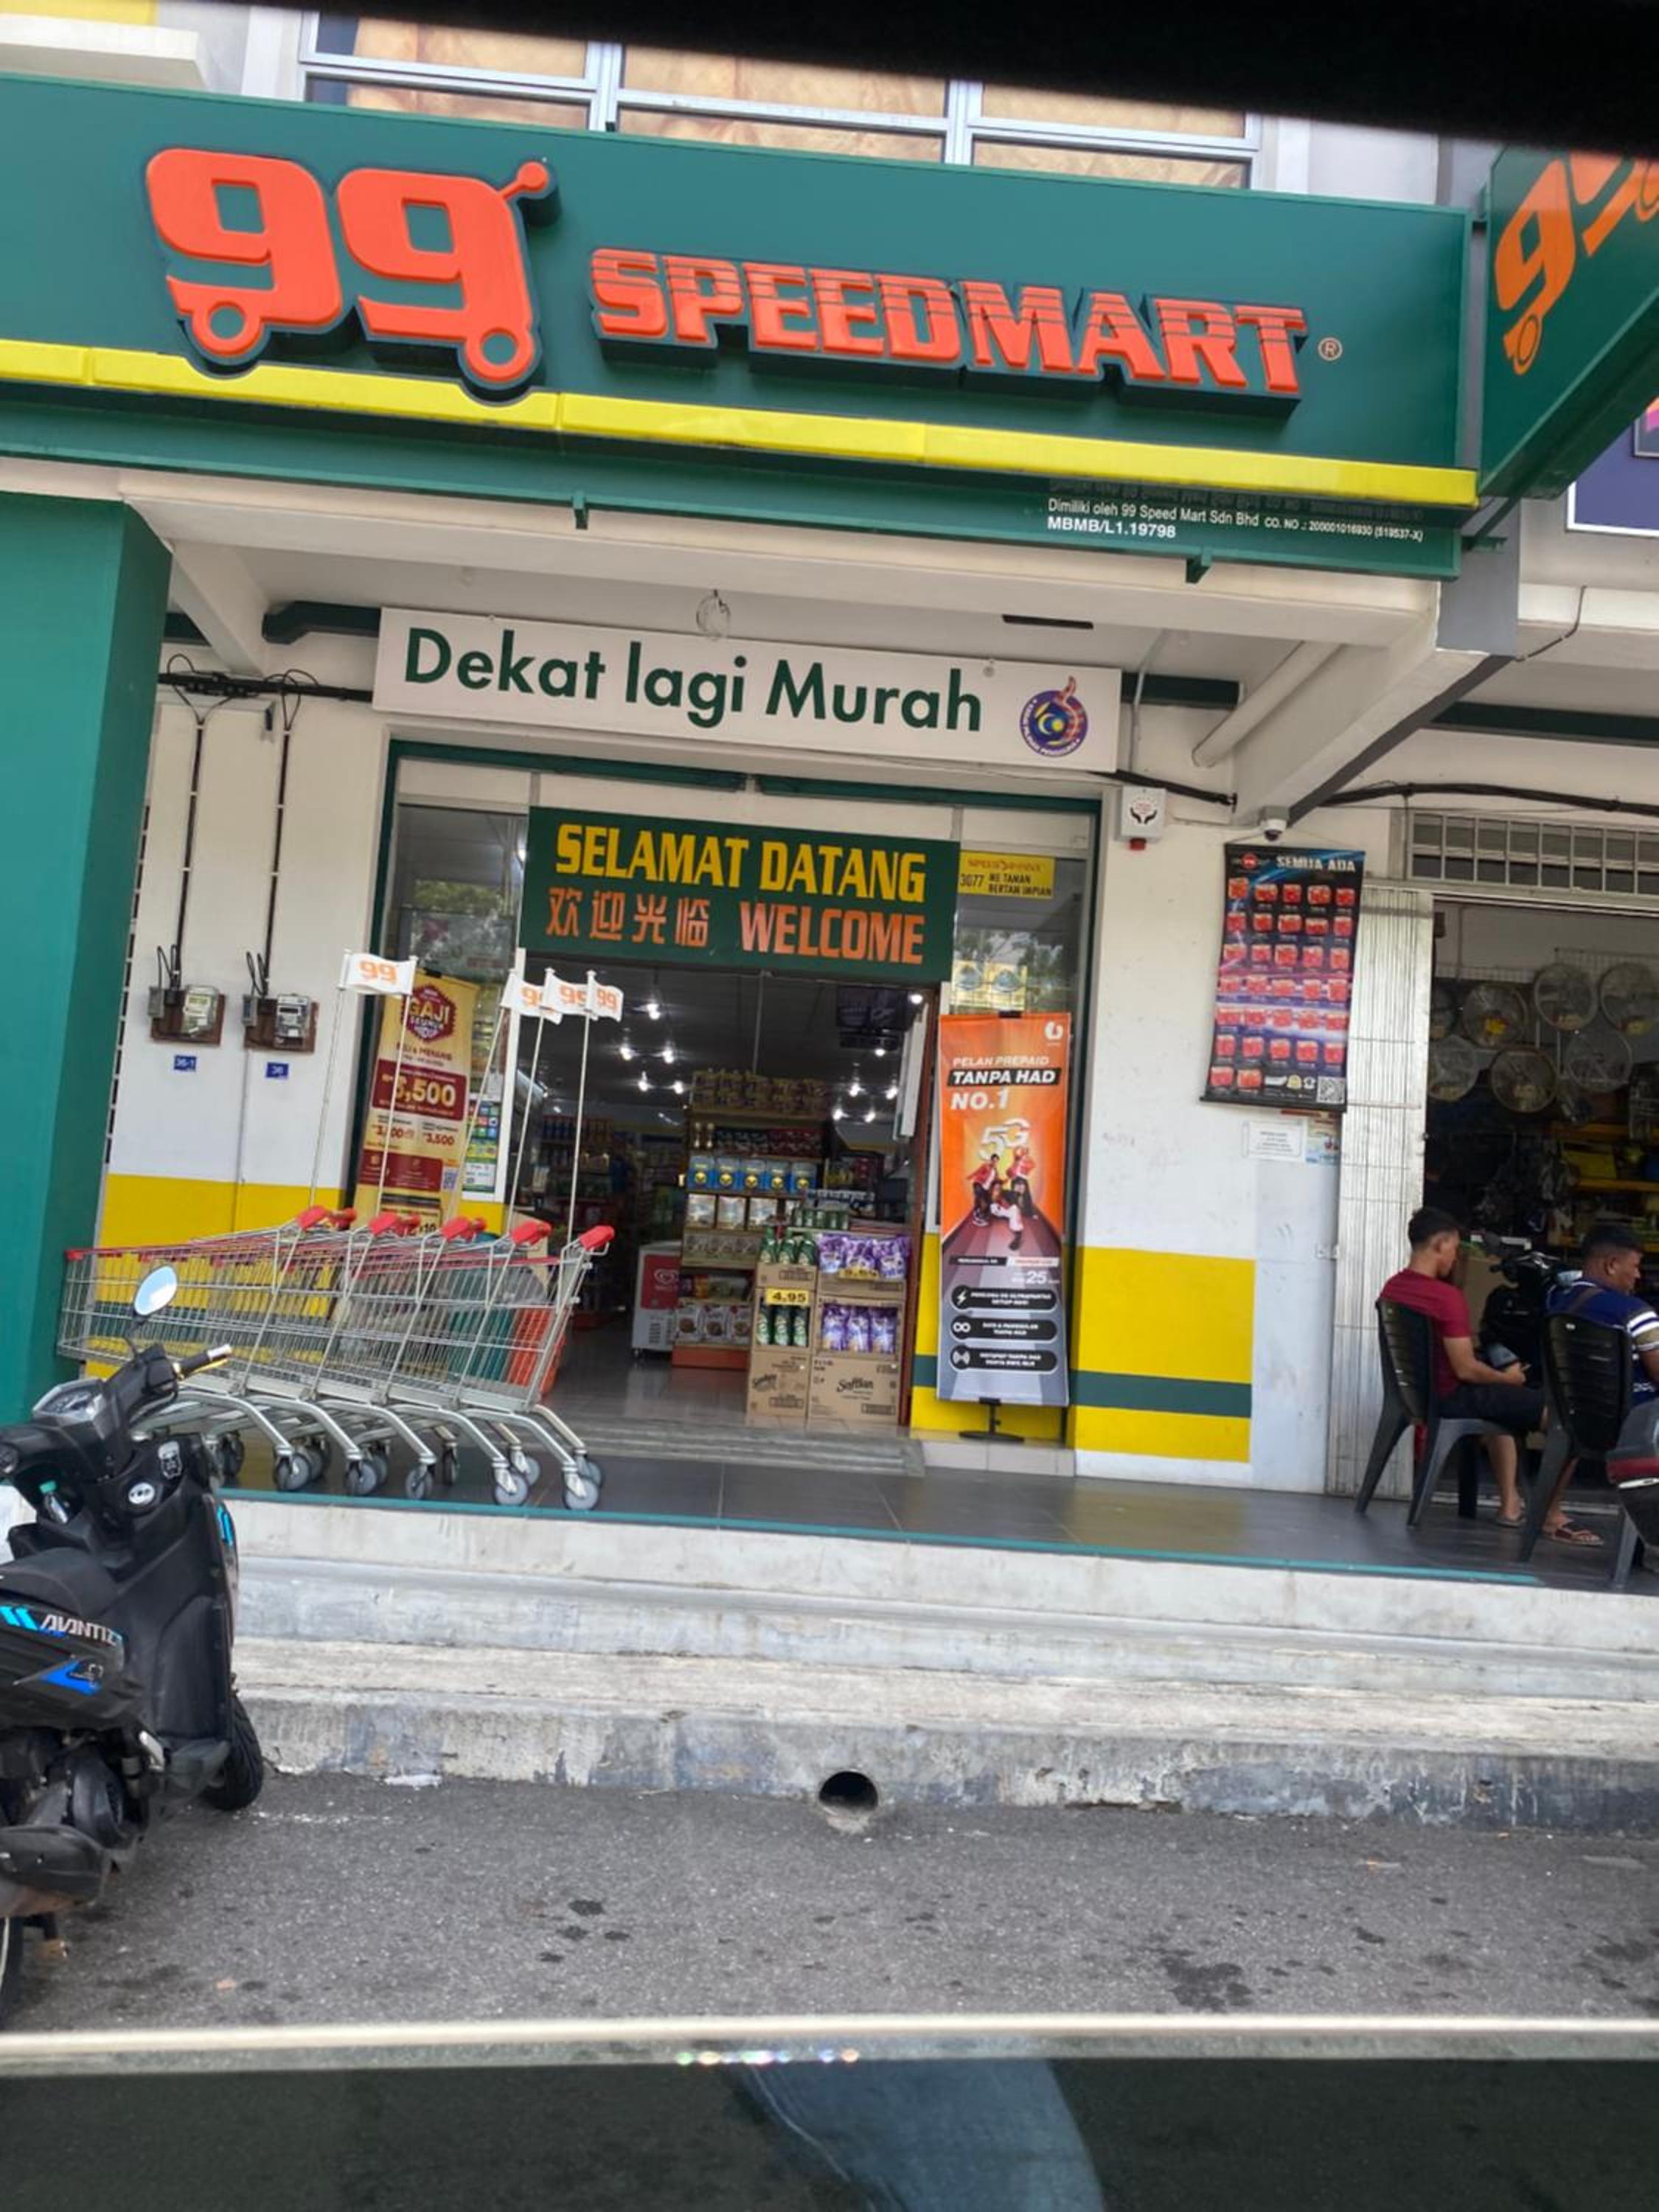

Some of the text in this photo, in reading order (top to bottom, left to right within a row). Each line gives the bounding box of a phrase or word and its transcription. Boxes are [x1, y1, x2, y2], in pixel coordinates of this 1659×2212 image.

[147, 147, 548, 382] 99
[591, 247, 1307, 394] SPEEDMART
[1048, 498, 1091, 515] Dimiliki
[1093, 502, 1119, 516] oleh
[1121, 503, 1136, 518] 99
[1139, 505, 1178, 521] Speed
[1180, 508, 1207, 523] Mart
[1209, 511, 1232, 524] Sdn
[1236, 512, 1259, 527] Bhd
[1047, 517, 1177, 538] MBMB/L1.19798
[404, 627, 606, 700] Dekat
[625, 641, 747, 729] lagi
[765, 658, 982, 731] Murah
[555, 824, 927, 903] SELAMAT DATANG
[1327, 859, 1356, 872] ADA
[546, 886, 710, 947] 欢迎光临
[739, 901, 927, 965] WELCOME
[360, 960, 397, 984] 99
[597, 988, 617, 1013] 99
[953, 1055, 1050, 1067] PELAN PREPAID
[953, 1069, 1056, 1085] TANPA HAD
[978, 1117, 1030, 1162] 5G
[1026, 1270, 1048, 1284] 25
[772, 1293, 807, 1303] 4.95
